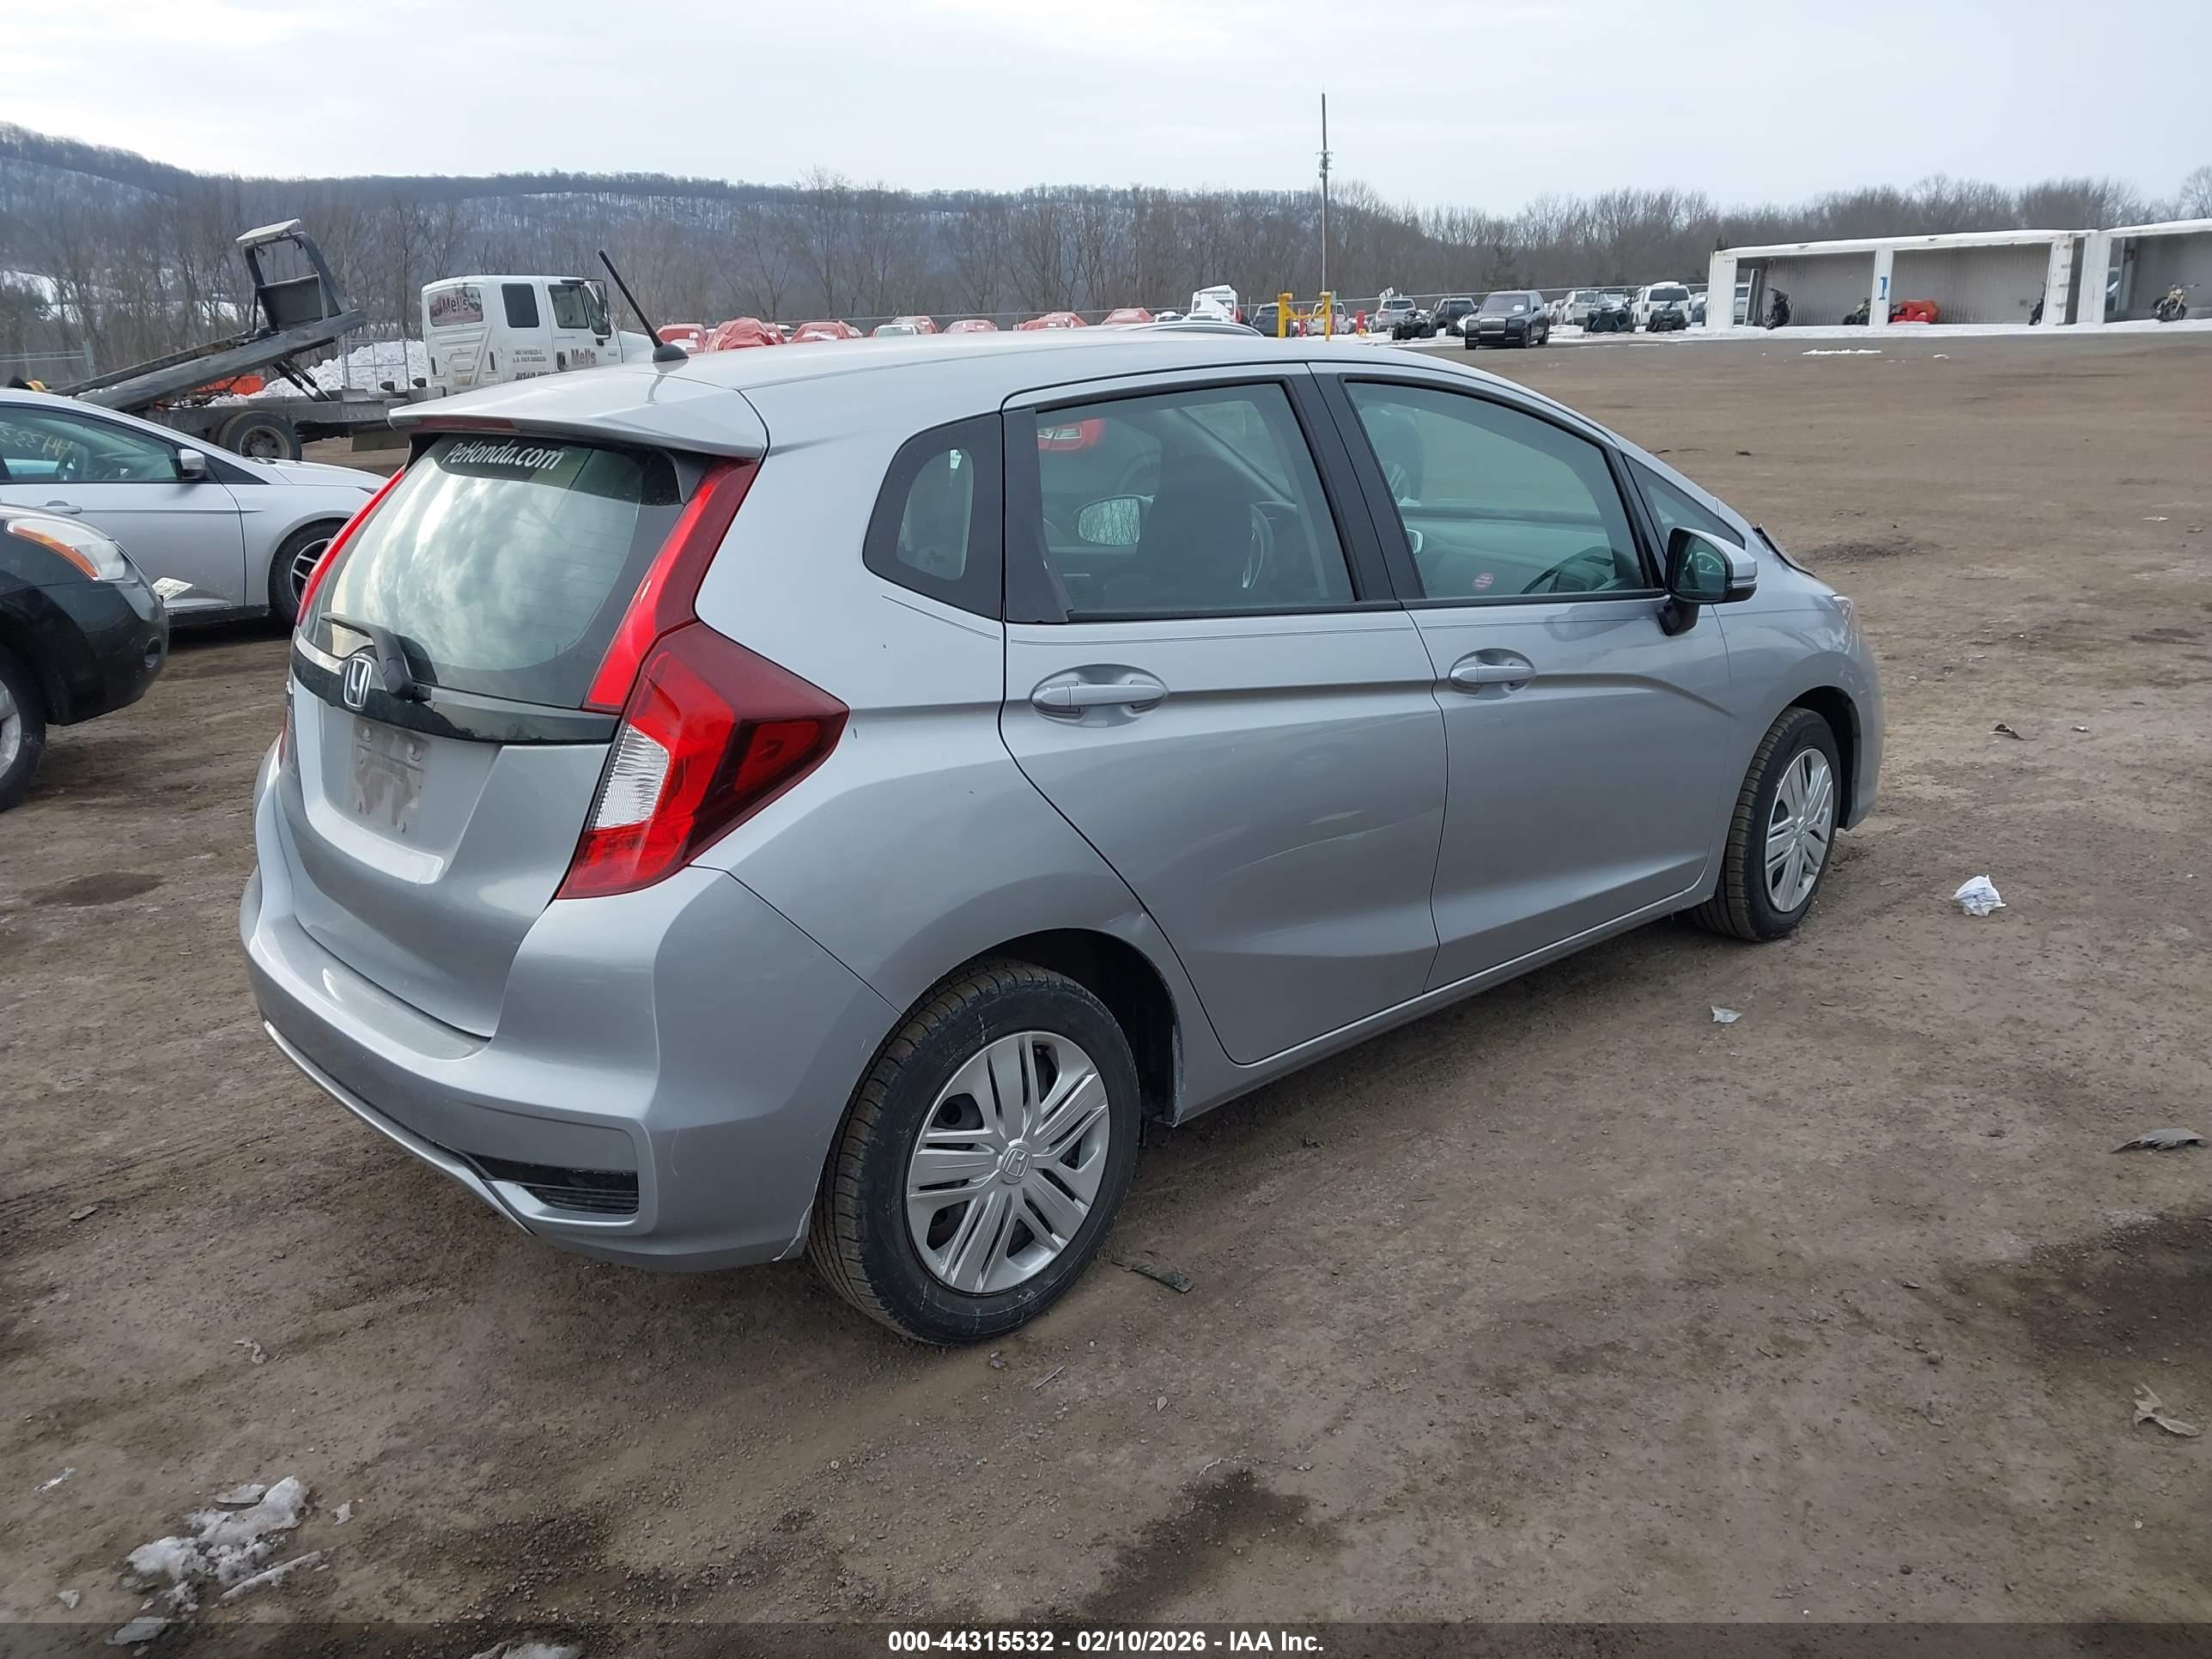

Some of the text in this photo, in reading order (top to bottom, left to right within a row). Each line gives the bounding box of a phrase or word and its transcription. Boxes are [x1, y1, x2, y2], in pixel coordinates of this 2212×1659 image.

[441, 295, 469, 313] Mel's
[571, 348, 597, 364] Mel's
[441, 439, 564, 470] PeHonda.com
